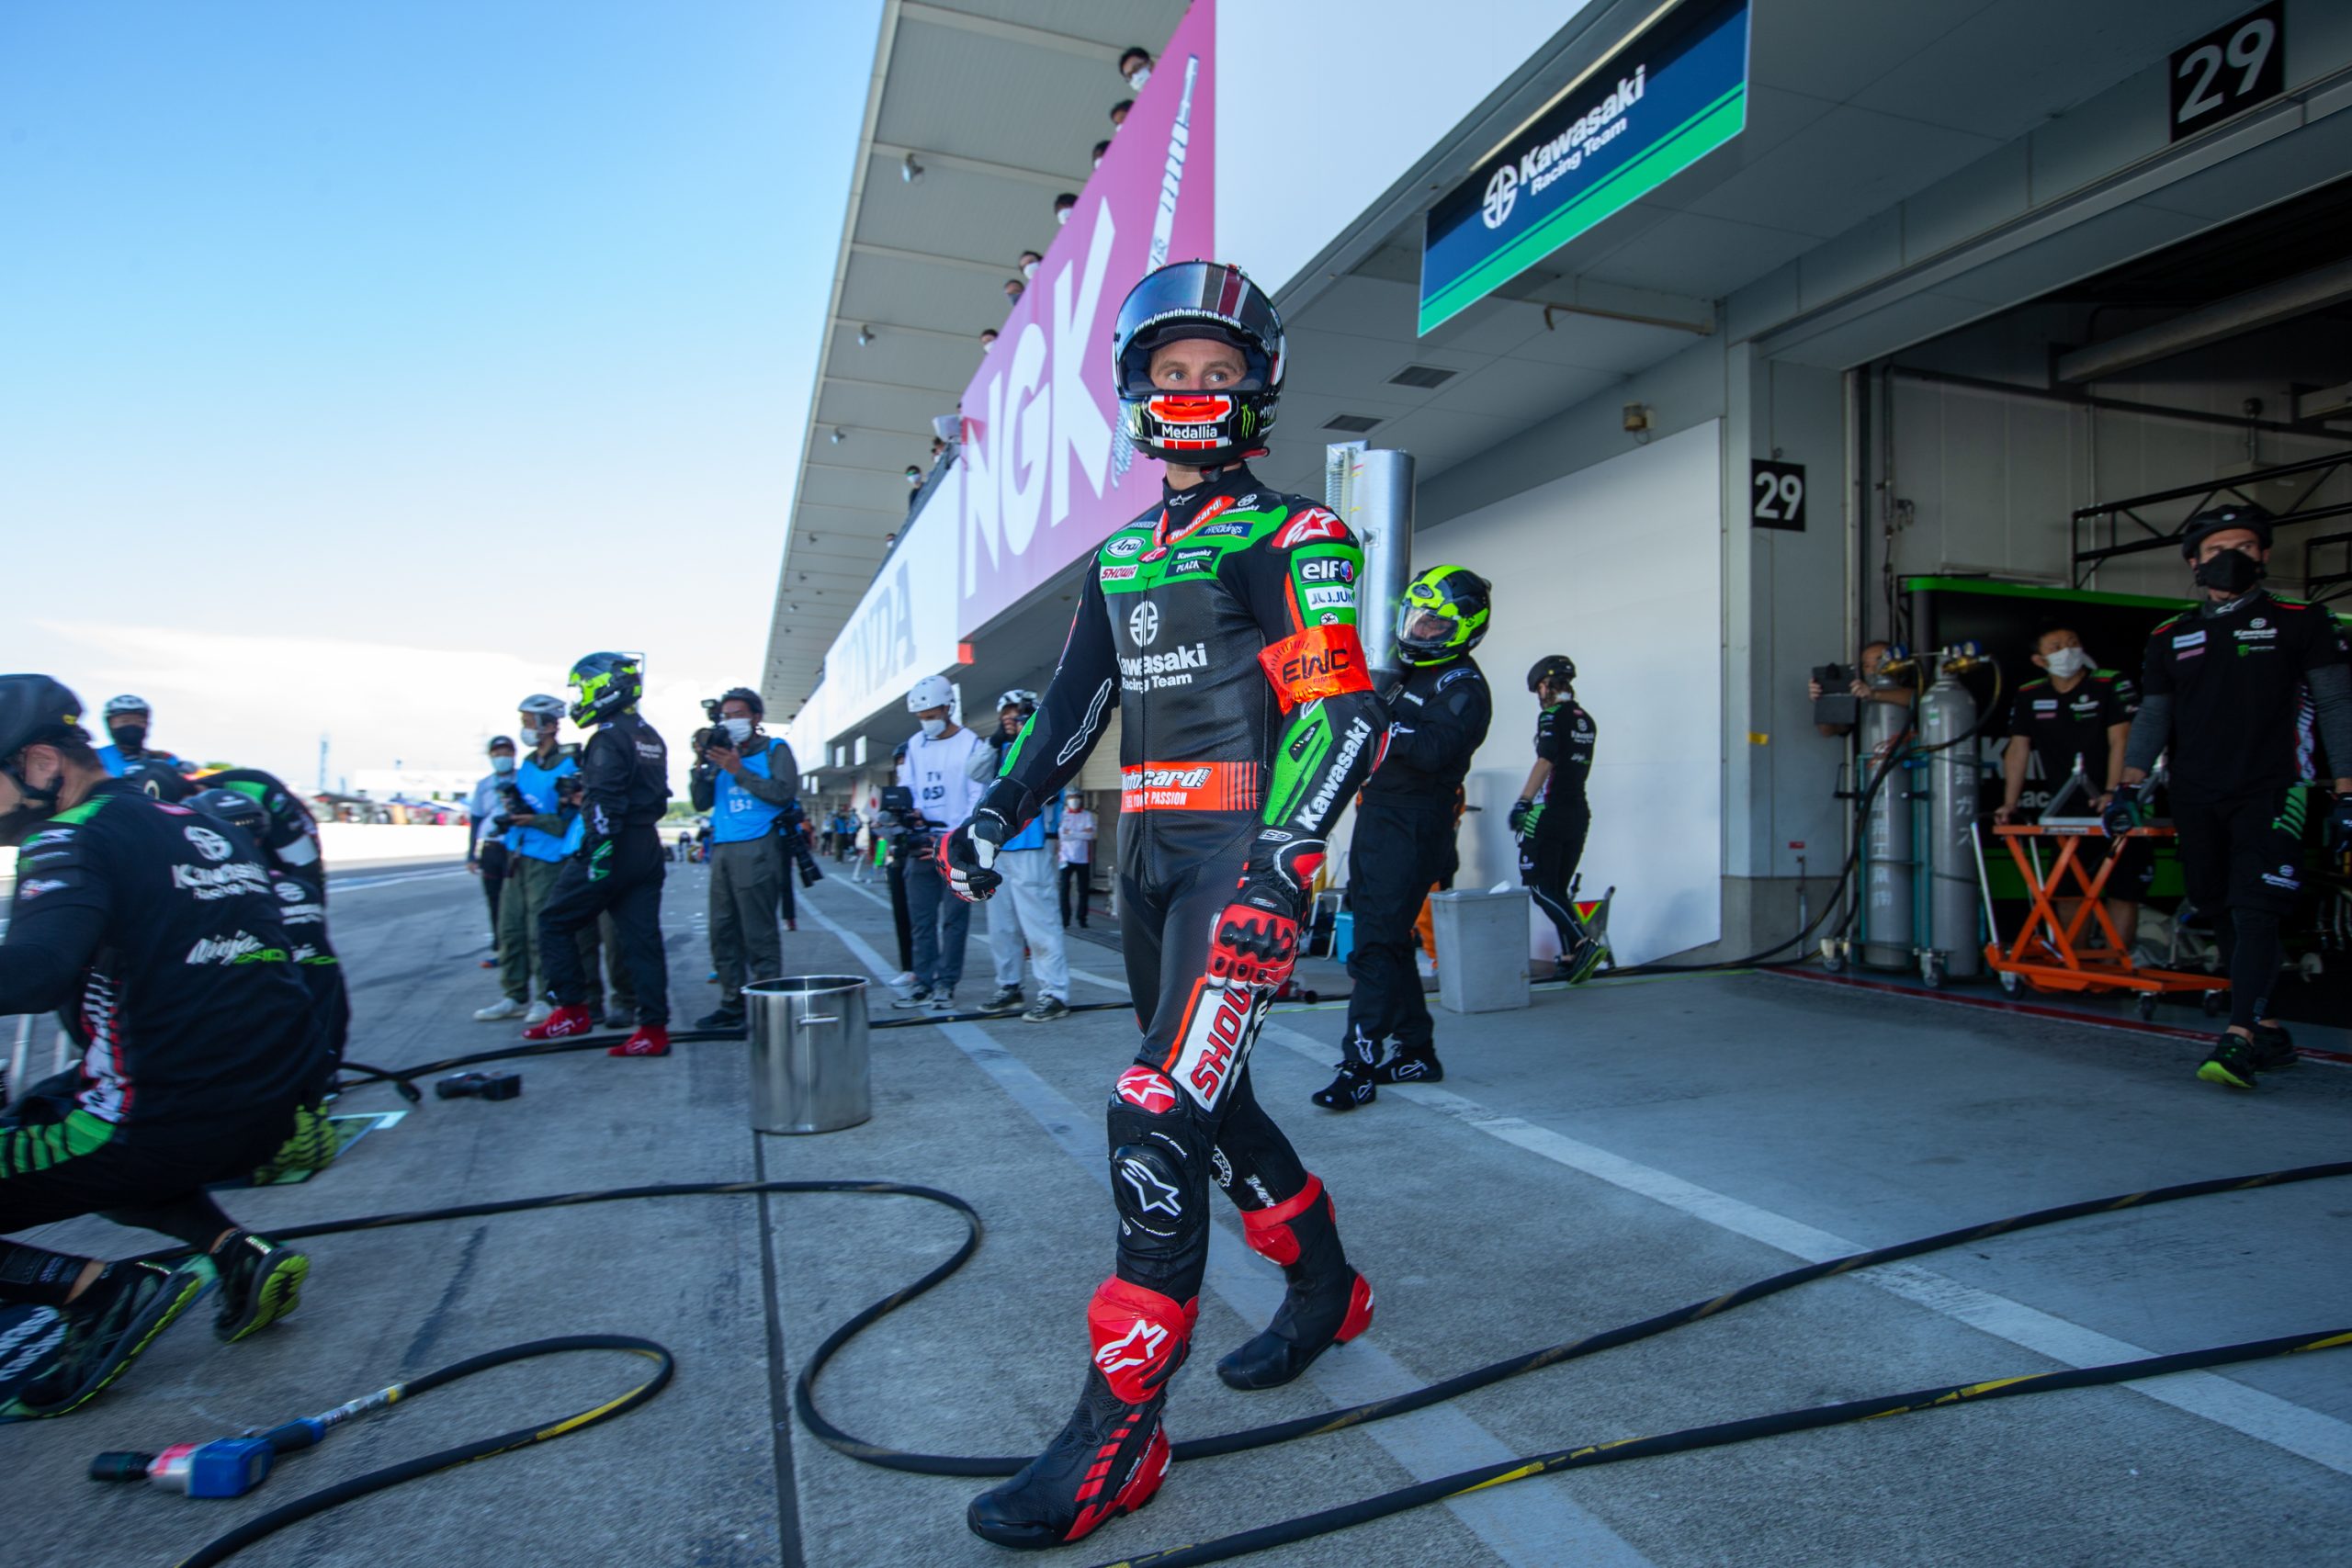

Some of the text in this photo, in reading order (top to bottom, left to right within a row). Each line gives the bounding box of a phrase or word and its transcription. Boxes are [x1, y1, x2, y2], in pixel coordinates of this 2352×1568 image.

[2177, 17, 2277, 125] 29
[1520, 63, 1645, 186] Kawasaki
[1531, 118, 1628, 197] Racing Team
[965, 196, 1115, 597] NGK
[1161, 423, 1218, 439] Medallia
[1754, 471, 1804, 521] 29
[1109, 538, 1139, 552] Arai
[1177, 549, 1213, 560] Kawasaki
[1102, 566, 1136, 580] SHOWA
[1176, 559, 1200, 573] PLAZA
[1302, 559, 1340, 580] elf
[1117, 643, 1208, 676] awasaki
[1282, 649, 1350, 684] EWC
[1151, 673, 1193, 689] Team
[1295, 716, 1372, 832] Kawasaki
[1150, 791, 1188, 806] PASSION
